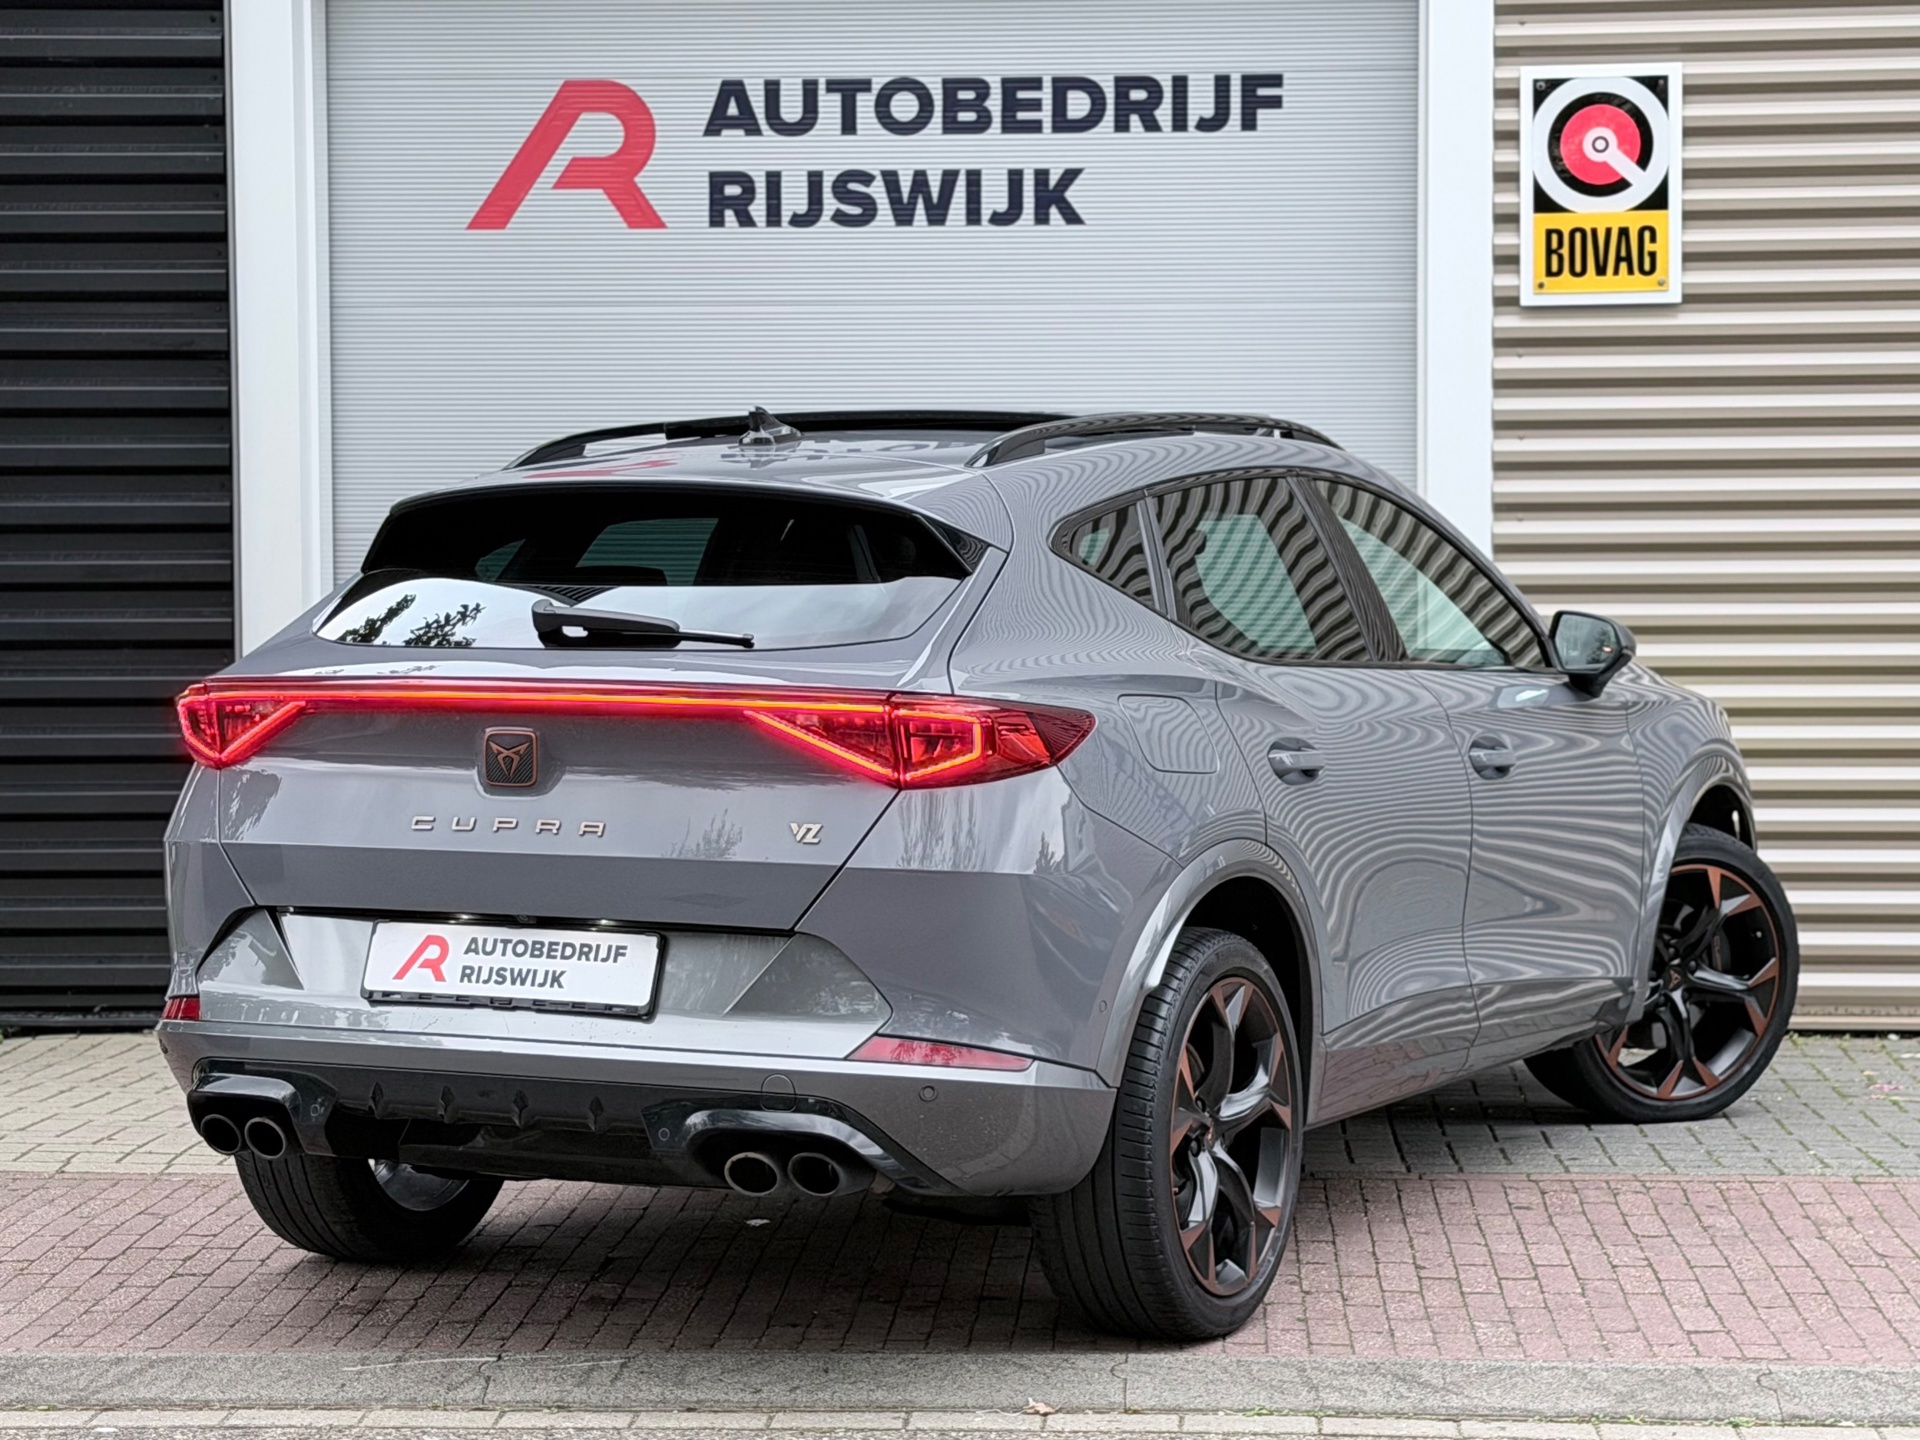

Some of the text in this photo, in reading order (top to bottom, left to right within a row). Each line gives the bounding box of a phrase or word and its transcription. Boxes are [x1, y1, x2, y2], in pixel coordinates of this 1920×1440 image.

[703, 74, 1284, 136] AUTOBEDRIJF
[708, 168, 1086, 228] RIJSWIJK
[1545, 225, 1657, 277] BOVAG
[410, 815, 607, 837] CUPRA
[789, 822, 823, 845] VZ
[463, 937, 629, 964] AUTOBEDRIJF
[459, 966, 567, 989] RIJSWIJK
